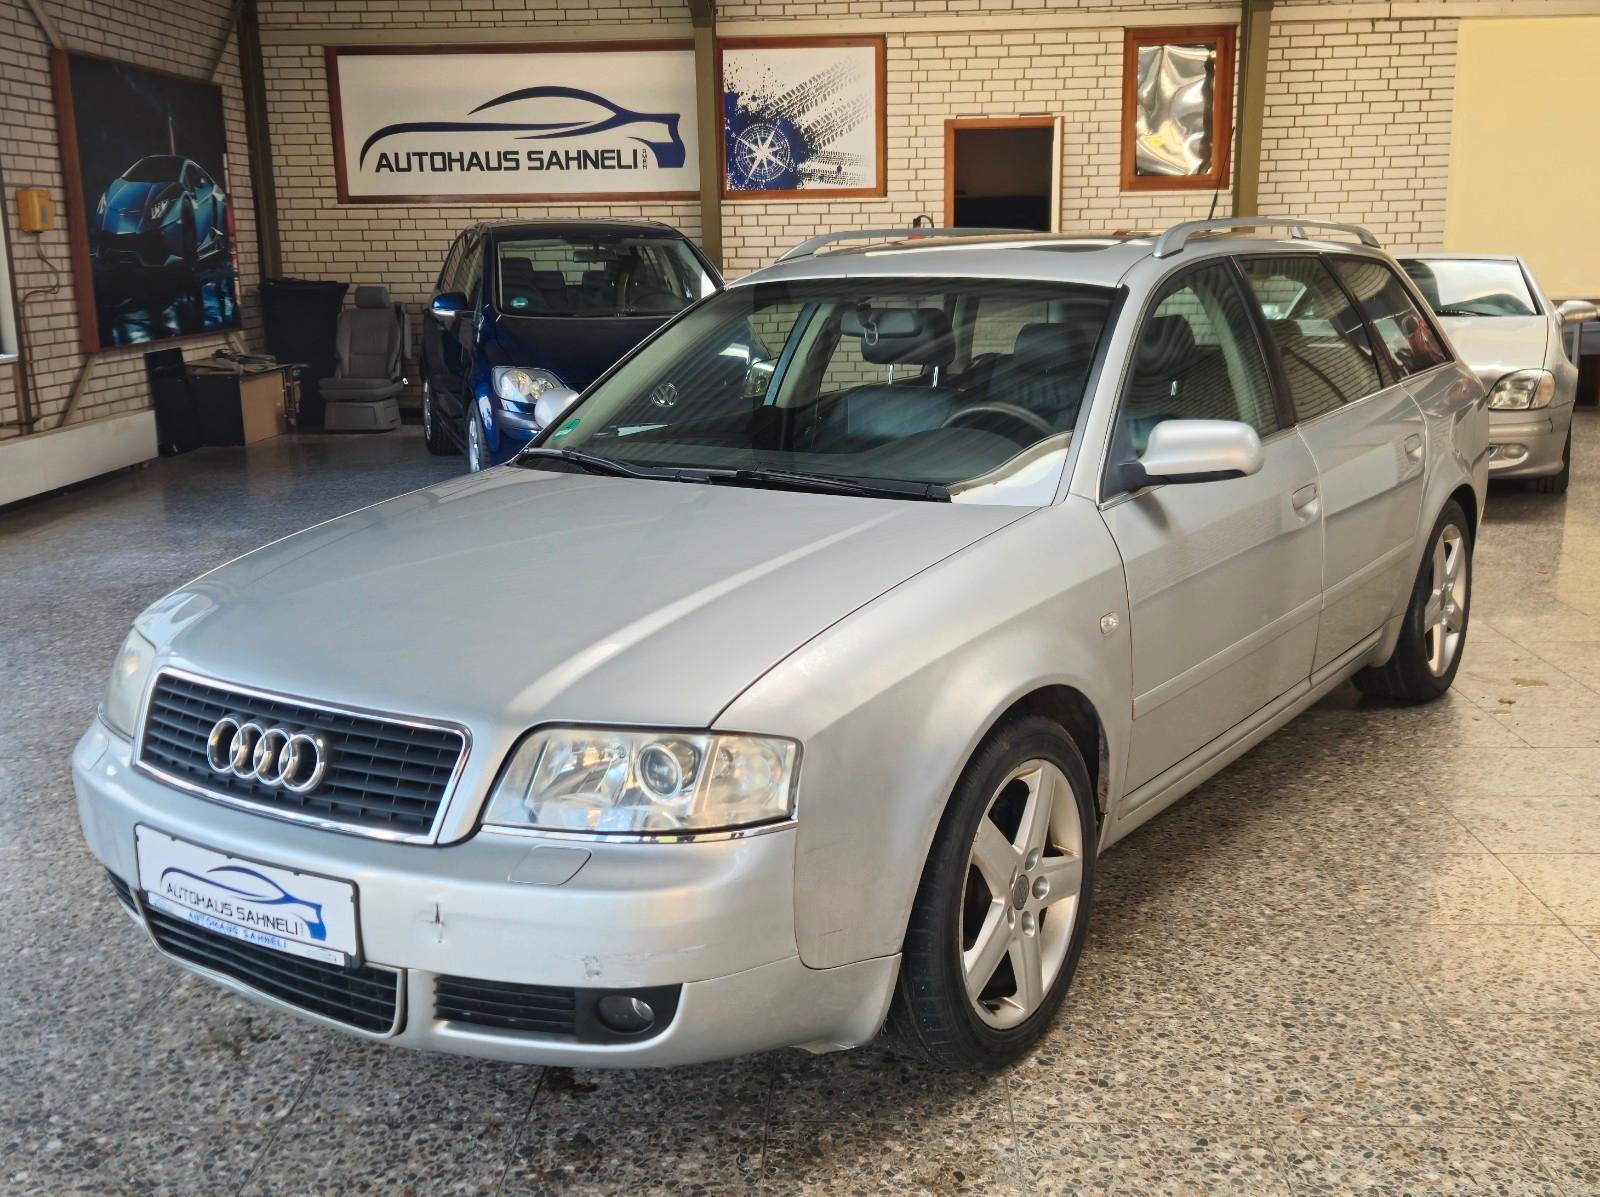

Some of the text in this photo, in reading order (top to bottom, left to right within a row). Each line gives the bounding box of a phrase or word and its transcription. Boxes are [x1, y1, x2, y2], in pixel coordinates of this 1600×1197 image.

[375, 149, 638, 173] AUTOHAUS SAHNELI
[167, 882, 233, 916] AUTOHAUS
[236, 906, 299, 936] SAHNELI
